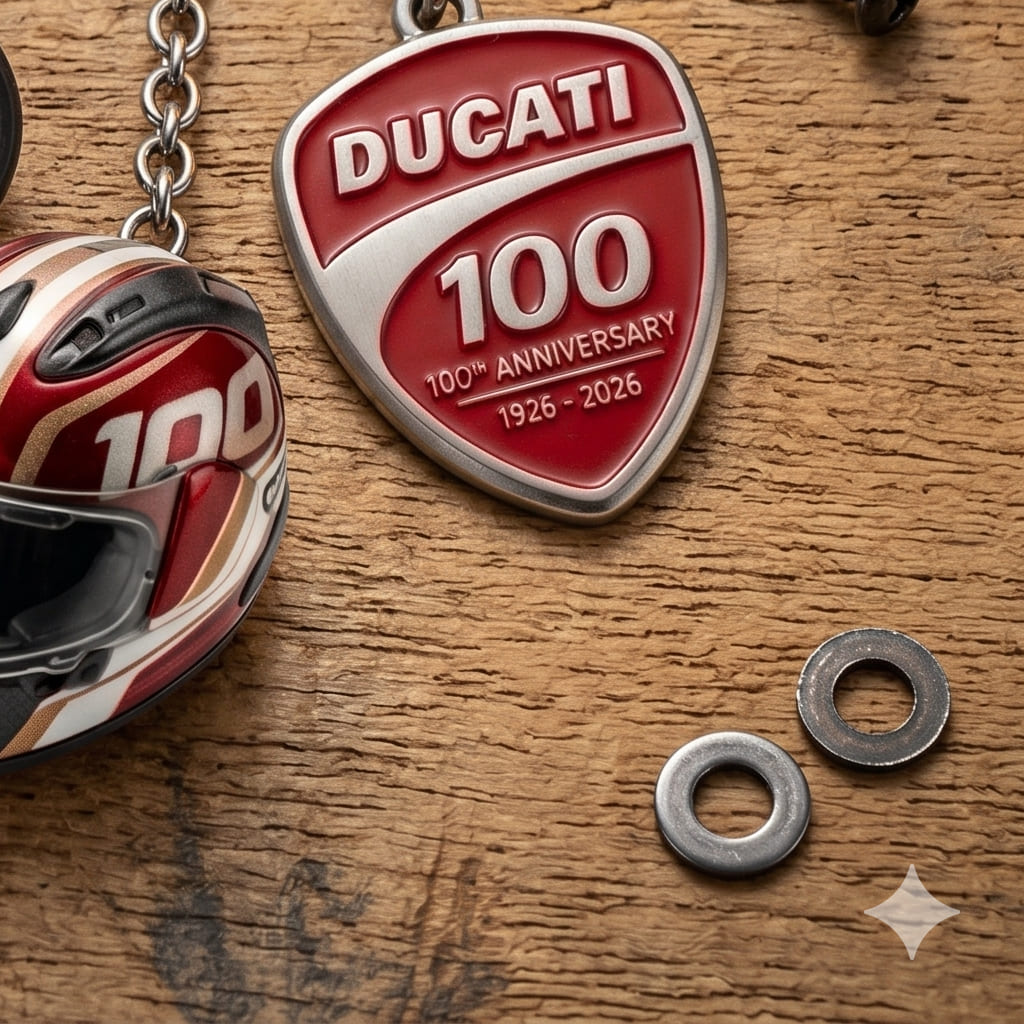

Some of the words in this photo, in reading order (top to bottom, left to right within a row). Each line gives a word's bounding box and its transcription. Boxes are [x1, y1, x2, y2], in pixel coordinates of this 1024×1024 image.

[331, 63, 633, 196] DUCATI
[440, 214, 653, 346] 100
[496, 311, 676, 382] ANNIVERSARY
[497, 394, 557, 430] 1926
[578, 372, 643, 409] 2026
[94, 352, 275, 502] 100
